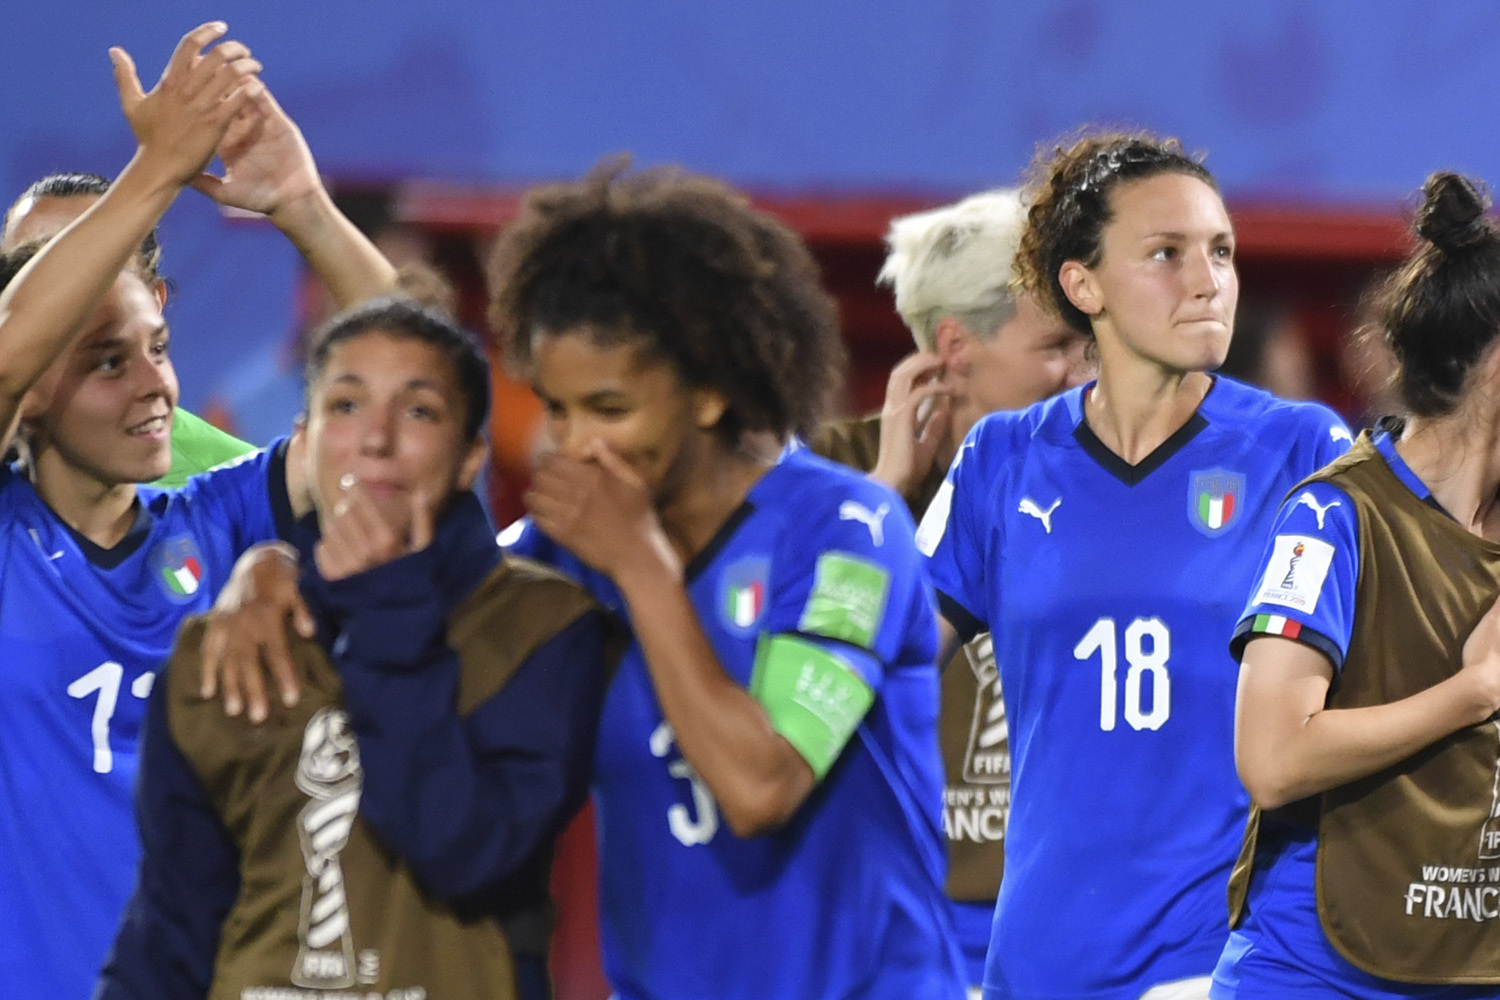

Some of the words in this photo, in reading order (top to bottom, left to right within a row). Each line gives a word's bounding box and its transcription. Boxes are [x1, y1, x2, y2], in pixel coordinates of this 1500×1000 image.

[67, 660, 156, 774] 1
[1074, 617, 1171, 732] 18
[649, 720, 720, 848] 3
